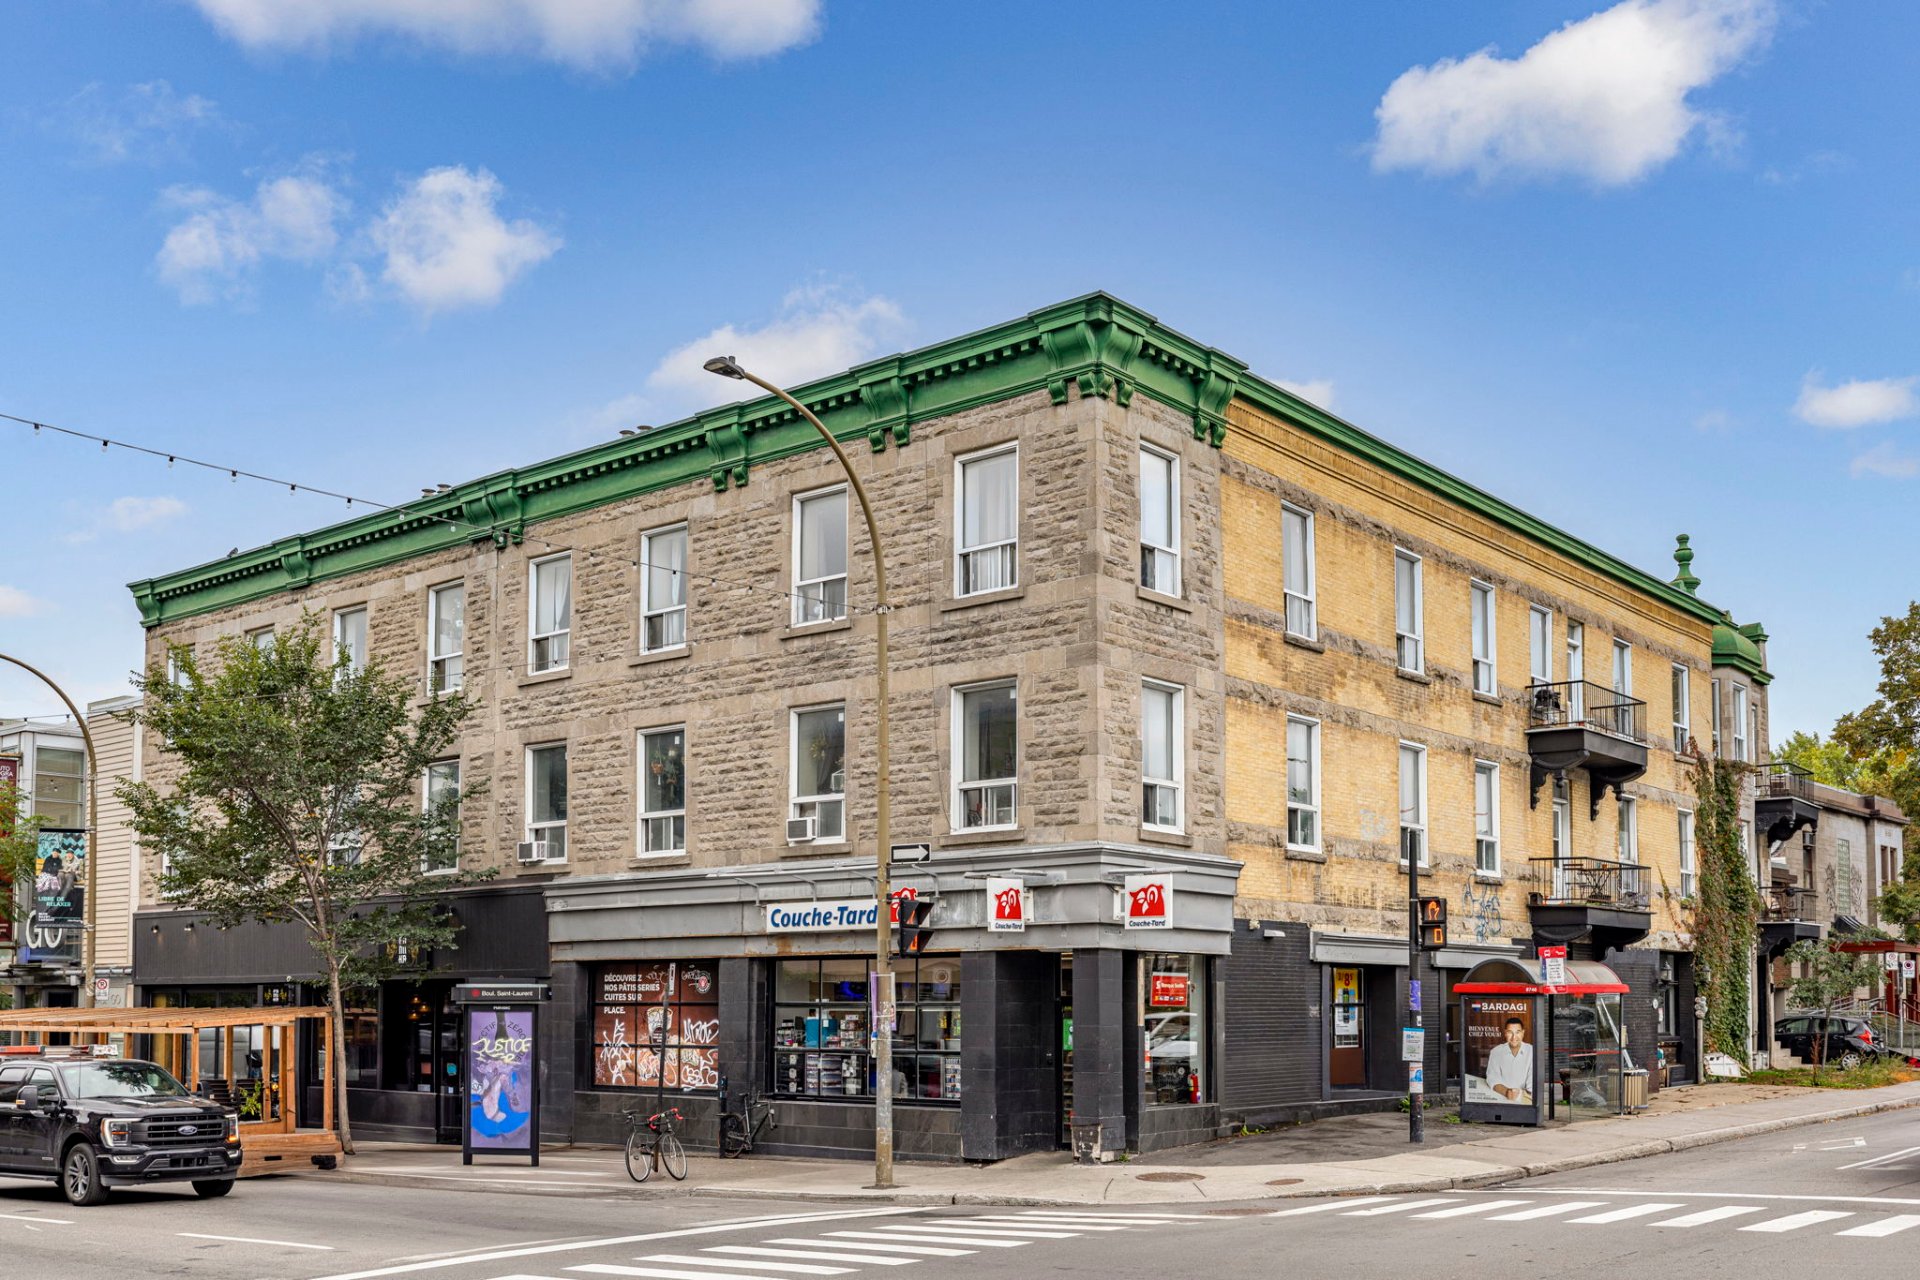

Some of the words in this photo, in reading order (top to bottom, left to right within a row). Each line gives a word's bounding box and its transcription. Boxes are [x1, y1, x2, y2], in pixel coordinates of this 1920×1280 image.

[770, 904, 877, 928] Couche-Tard
[995, 921, 1023, 930] Couche-Tard
[1128, 919, 1166, 927] Couche-Tard
[604, 972, 643, 982] DÉCOUVREZ
[604, 983, 618, 992] NOS
[618, 982, 660, 992] PÂTISSERIES
[603, 993, 627, 1001] CUITES
[627, 993, 643, 1001] SUR
[1481, 1002, 1528, 1011] BARDAGI
